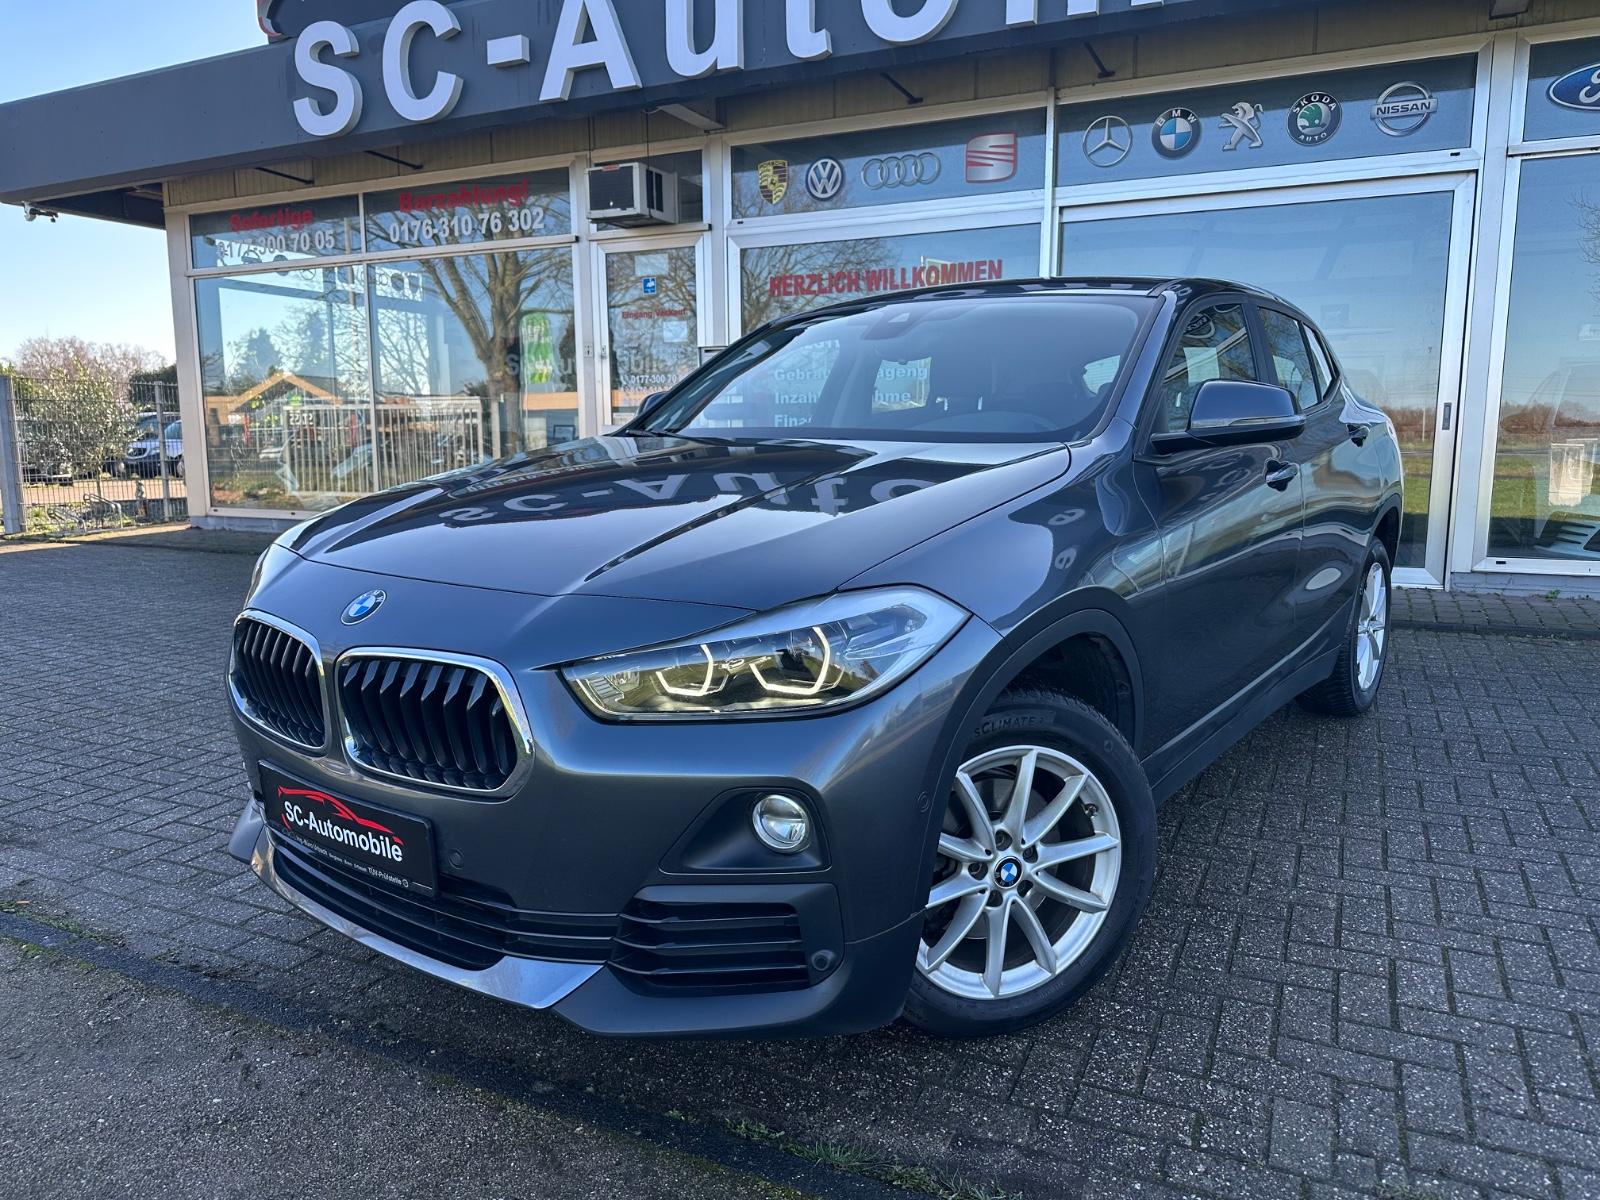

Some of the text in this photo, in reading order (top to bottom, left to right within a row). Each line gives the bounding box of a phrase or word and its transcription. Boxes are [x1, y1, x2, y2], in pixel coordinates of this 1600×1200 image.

[1157, 110, 1197, 127] BMW
[1376, 101, 1431, 116] NISSAN
[399, 178, 529, 212] Barzahlung!
[229, 207, 314, 232] Sofortige
[389, 208, 545, 243] 0176-310 76 302
[290, 233, 310, 251] 70
[315, 230, 335, 249] 05
[768, 258, 1003, 297] HERZLICH WILLKOMMEN
[284, 800, 403, 862] SC-Automobile
